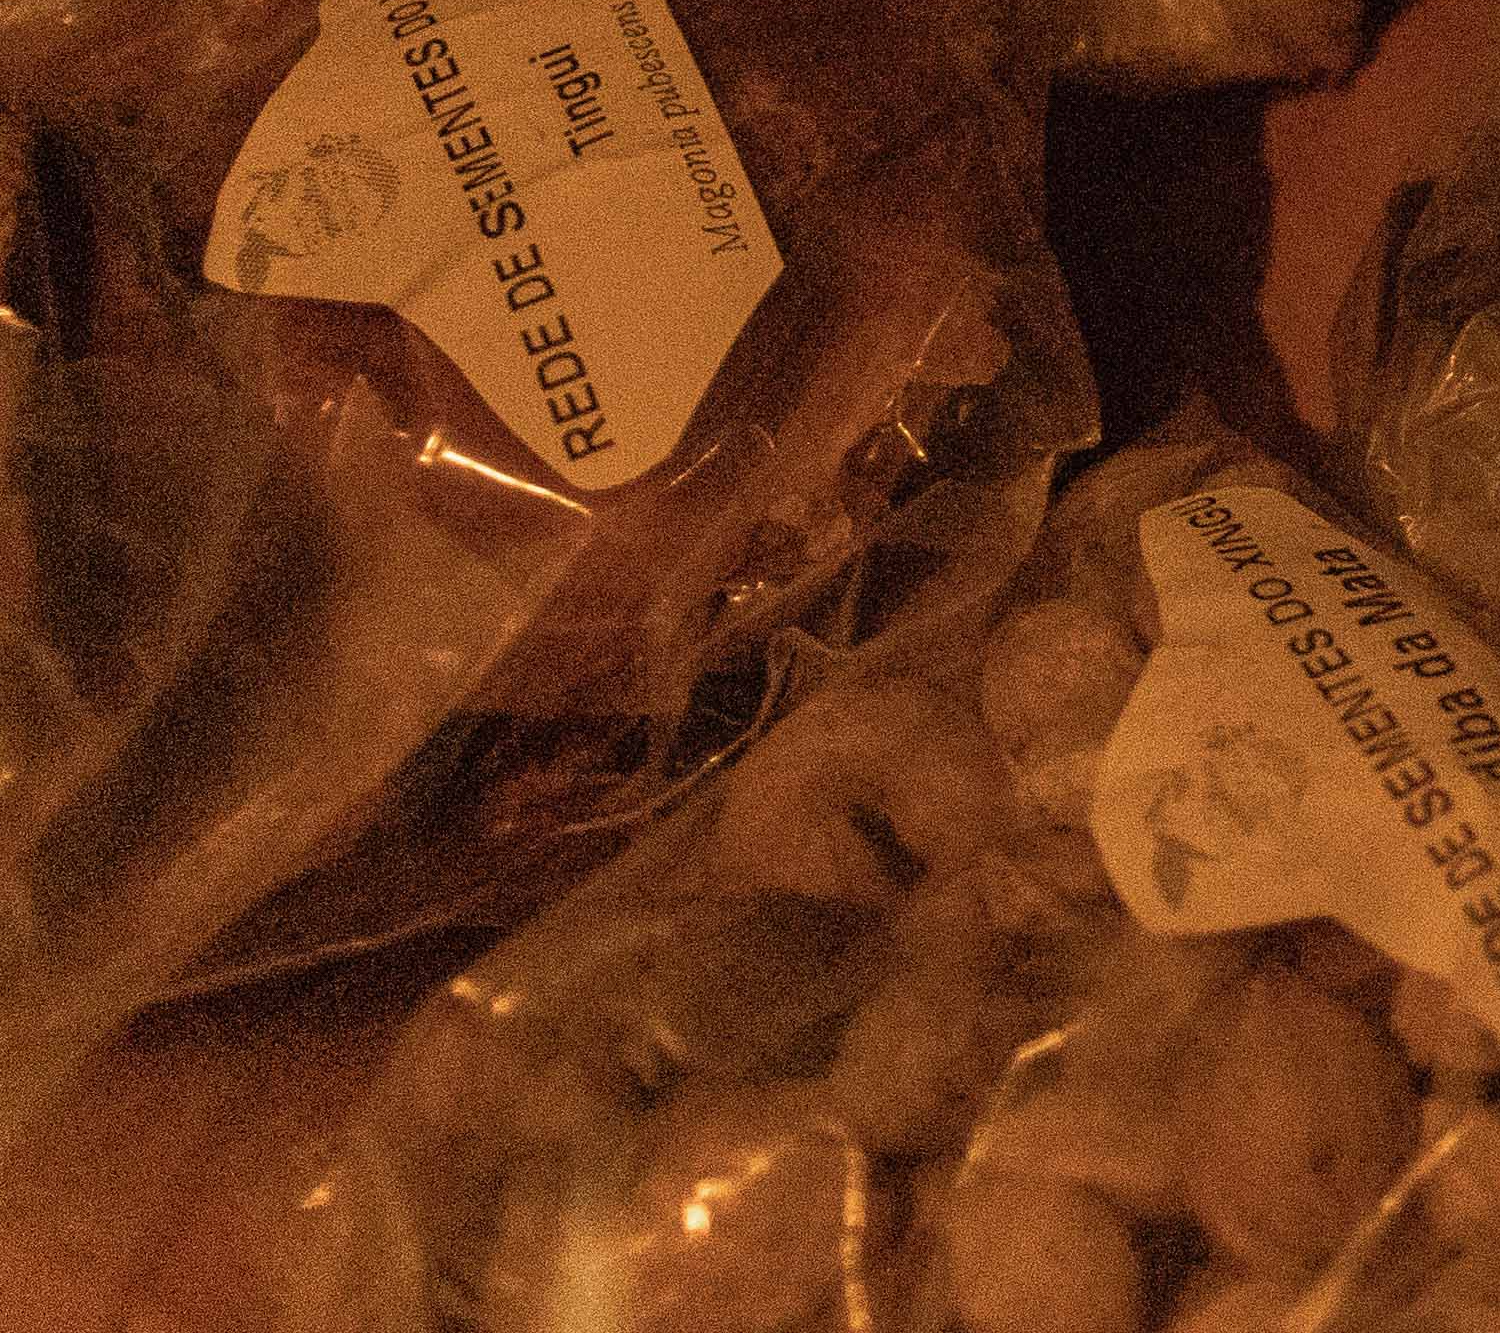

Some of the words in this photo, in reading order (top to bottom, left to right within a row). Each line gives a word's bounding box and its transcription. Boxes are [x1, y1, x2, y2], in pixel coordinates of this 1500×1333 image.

[387, 0, 437, 39] DO
[611, 0, 700, 119] pubescens
[404, 38, 526, 239] SEMENTES
[530, 43, 614, 157] Tingui
[672, 125, 748, 252] Magonia
[493, 244, 555, 311] DE
[521, 316, 614, 460] REDE
[1179, 489, 1272, 572] XINGU
[1248, 577, 1314, 626] DO
[1314, 547, 1412, 626] Mata
[1392, 630, 1456, 679] da
[1288, 628, 1452, 827] SEMENTES
[1428, 824, 1494, 889] DE
